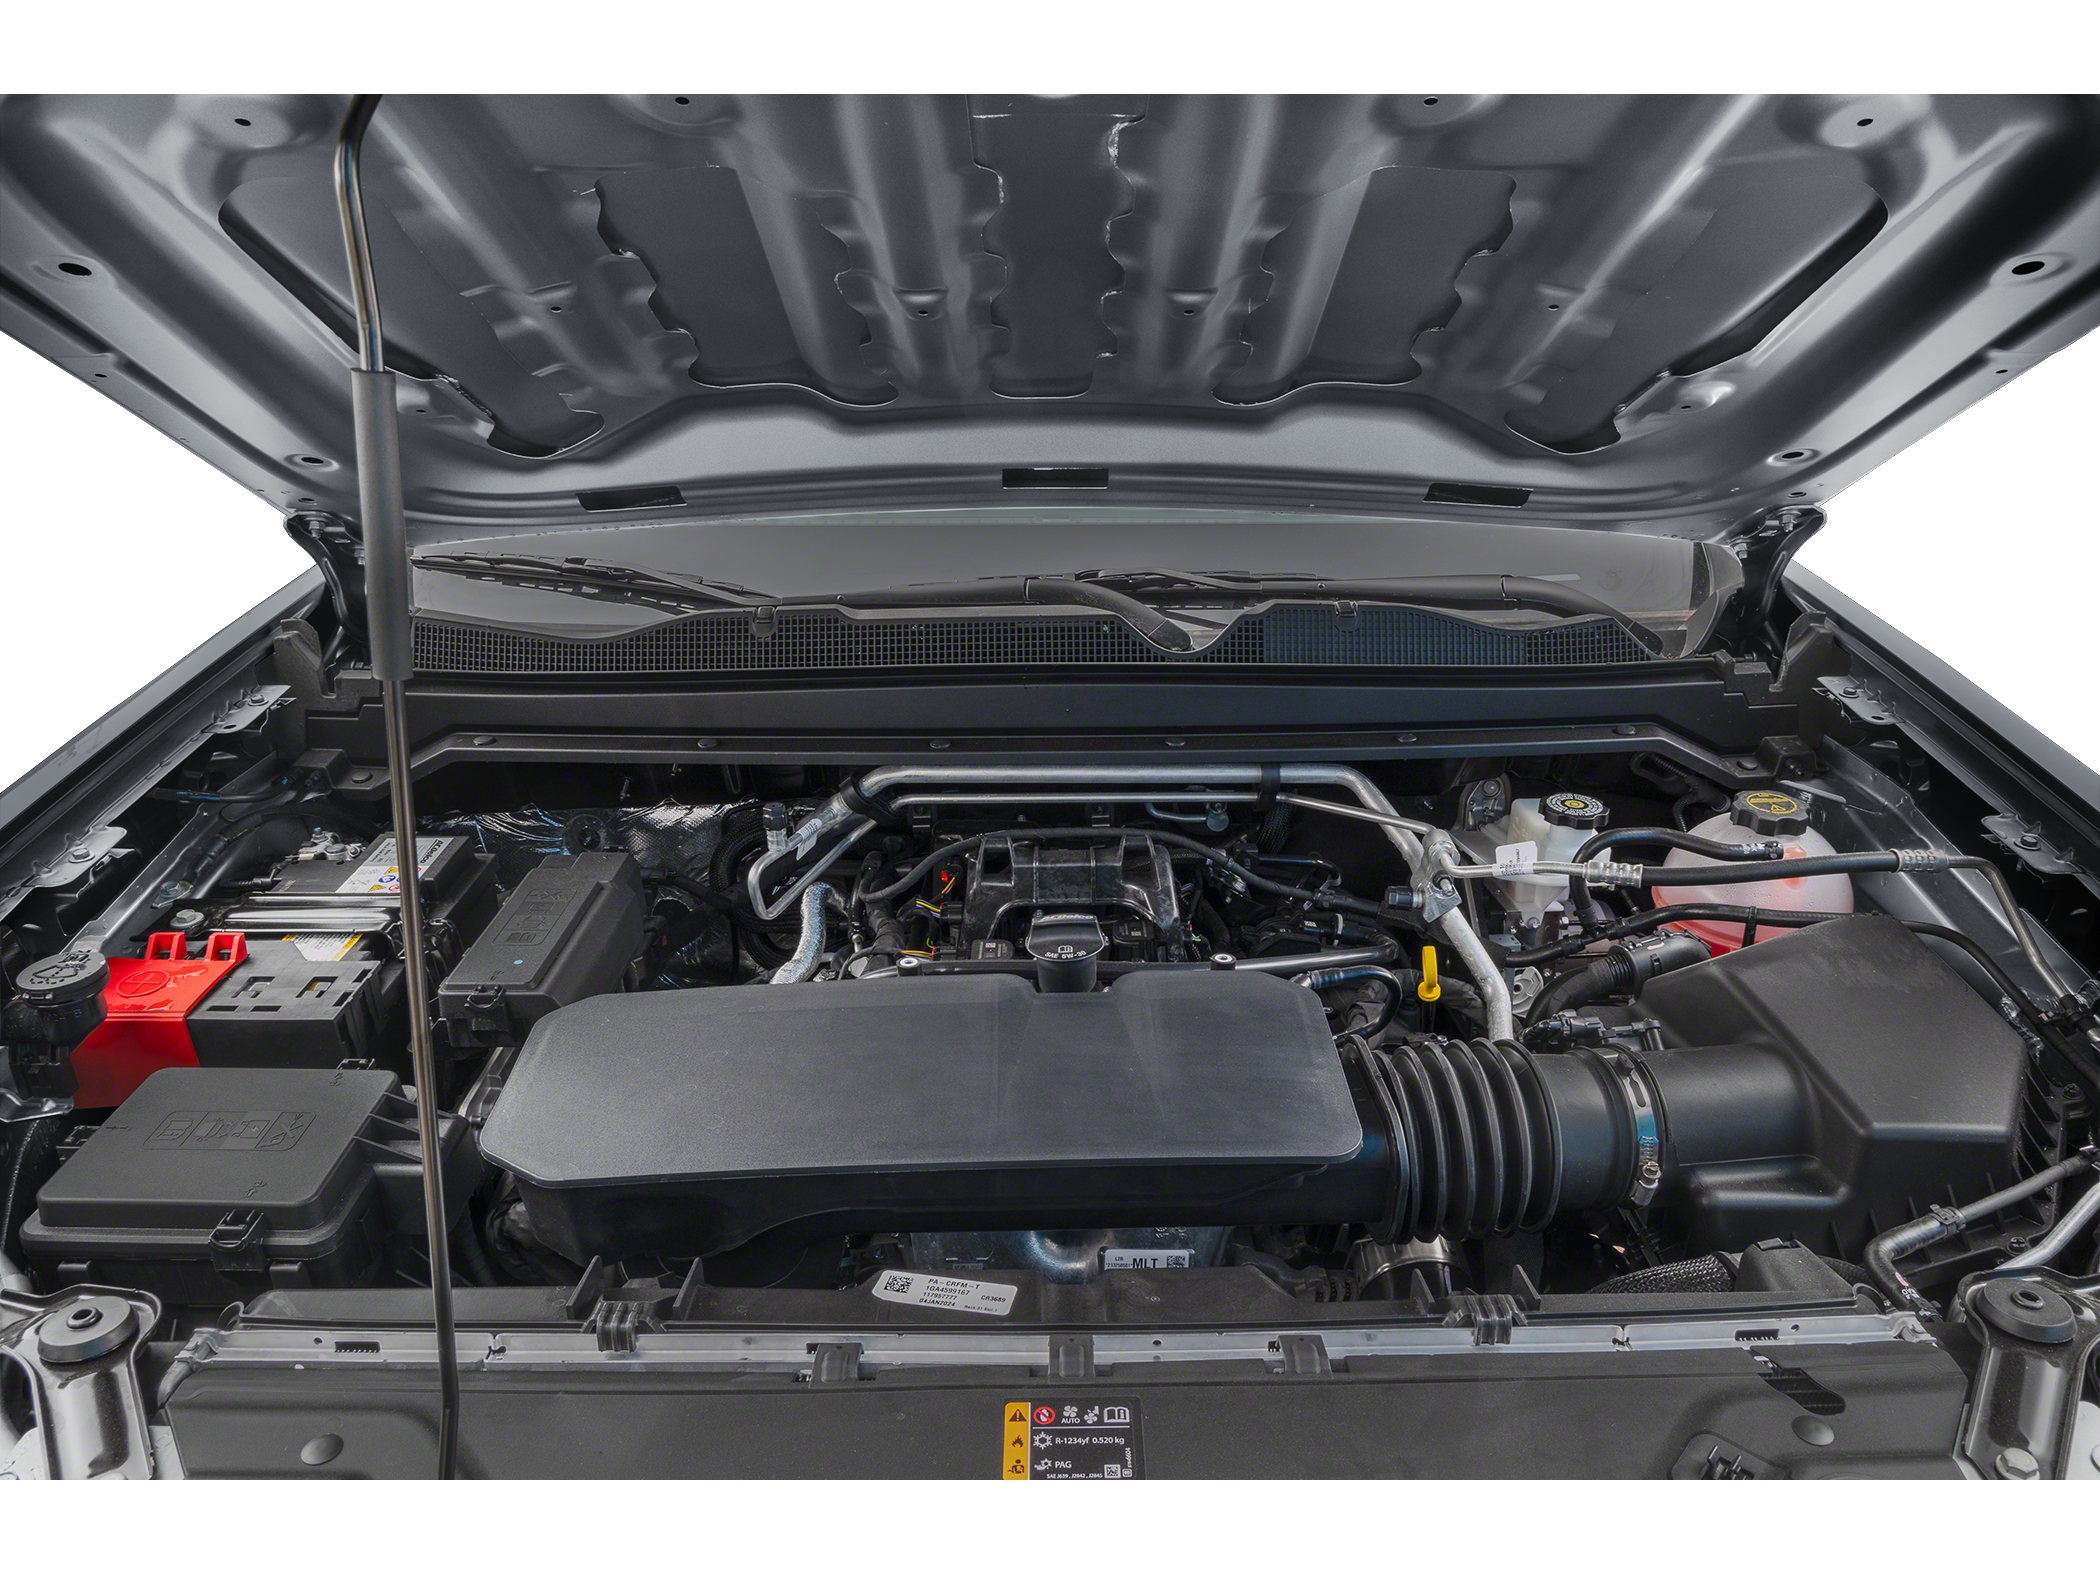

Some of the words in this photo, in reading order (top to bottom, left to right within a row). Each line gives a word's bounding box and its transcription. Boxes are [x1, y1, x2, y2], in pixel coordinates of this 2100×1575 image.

[1044, 951, 1059, 959] SAE
[1061, 950, 1087, 959] 5W-30
[1132, 1257, 1158, 1269] MLT
[926, 1285, 971, 1296] 1GA4599167
[922, 1292, 958, 1301] 117957777
[918, 1298, 956, 1307] 04JAN2024
[1055, 1437, 1090, 1445] R-1234yf
[1115, 1437, 1125, 1445] kg
[1055, 1461, 1072, 1469] PAG
